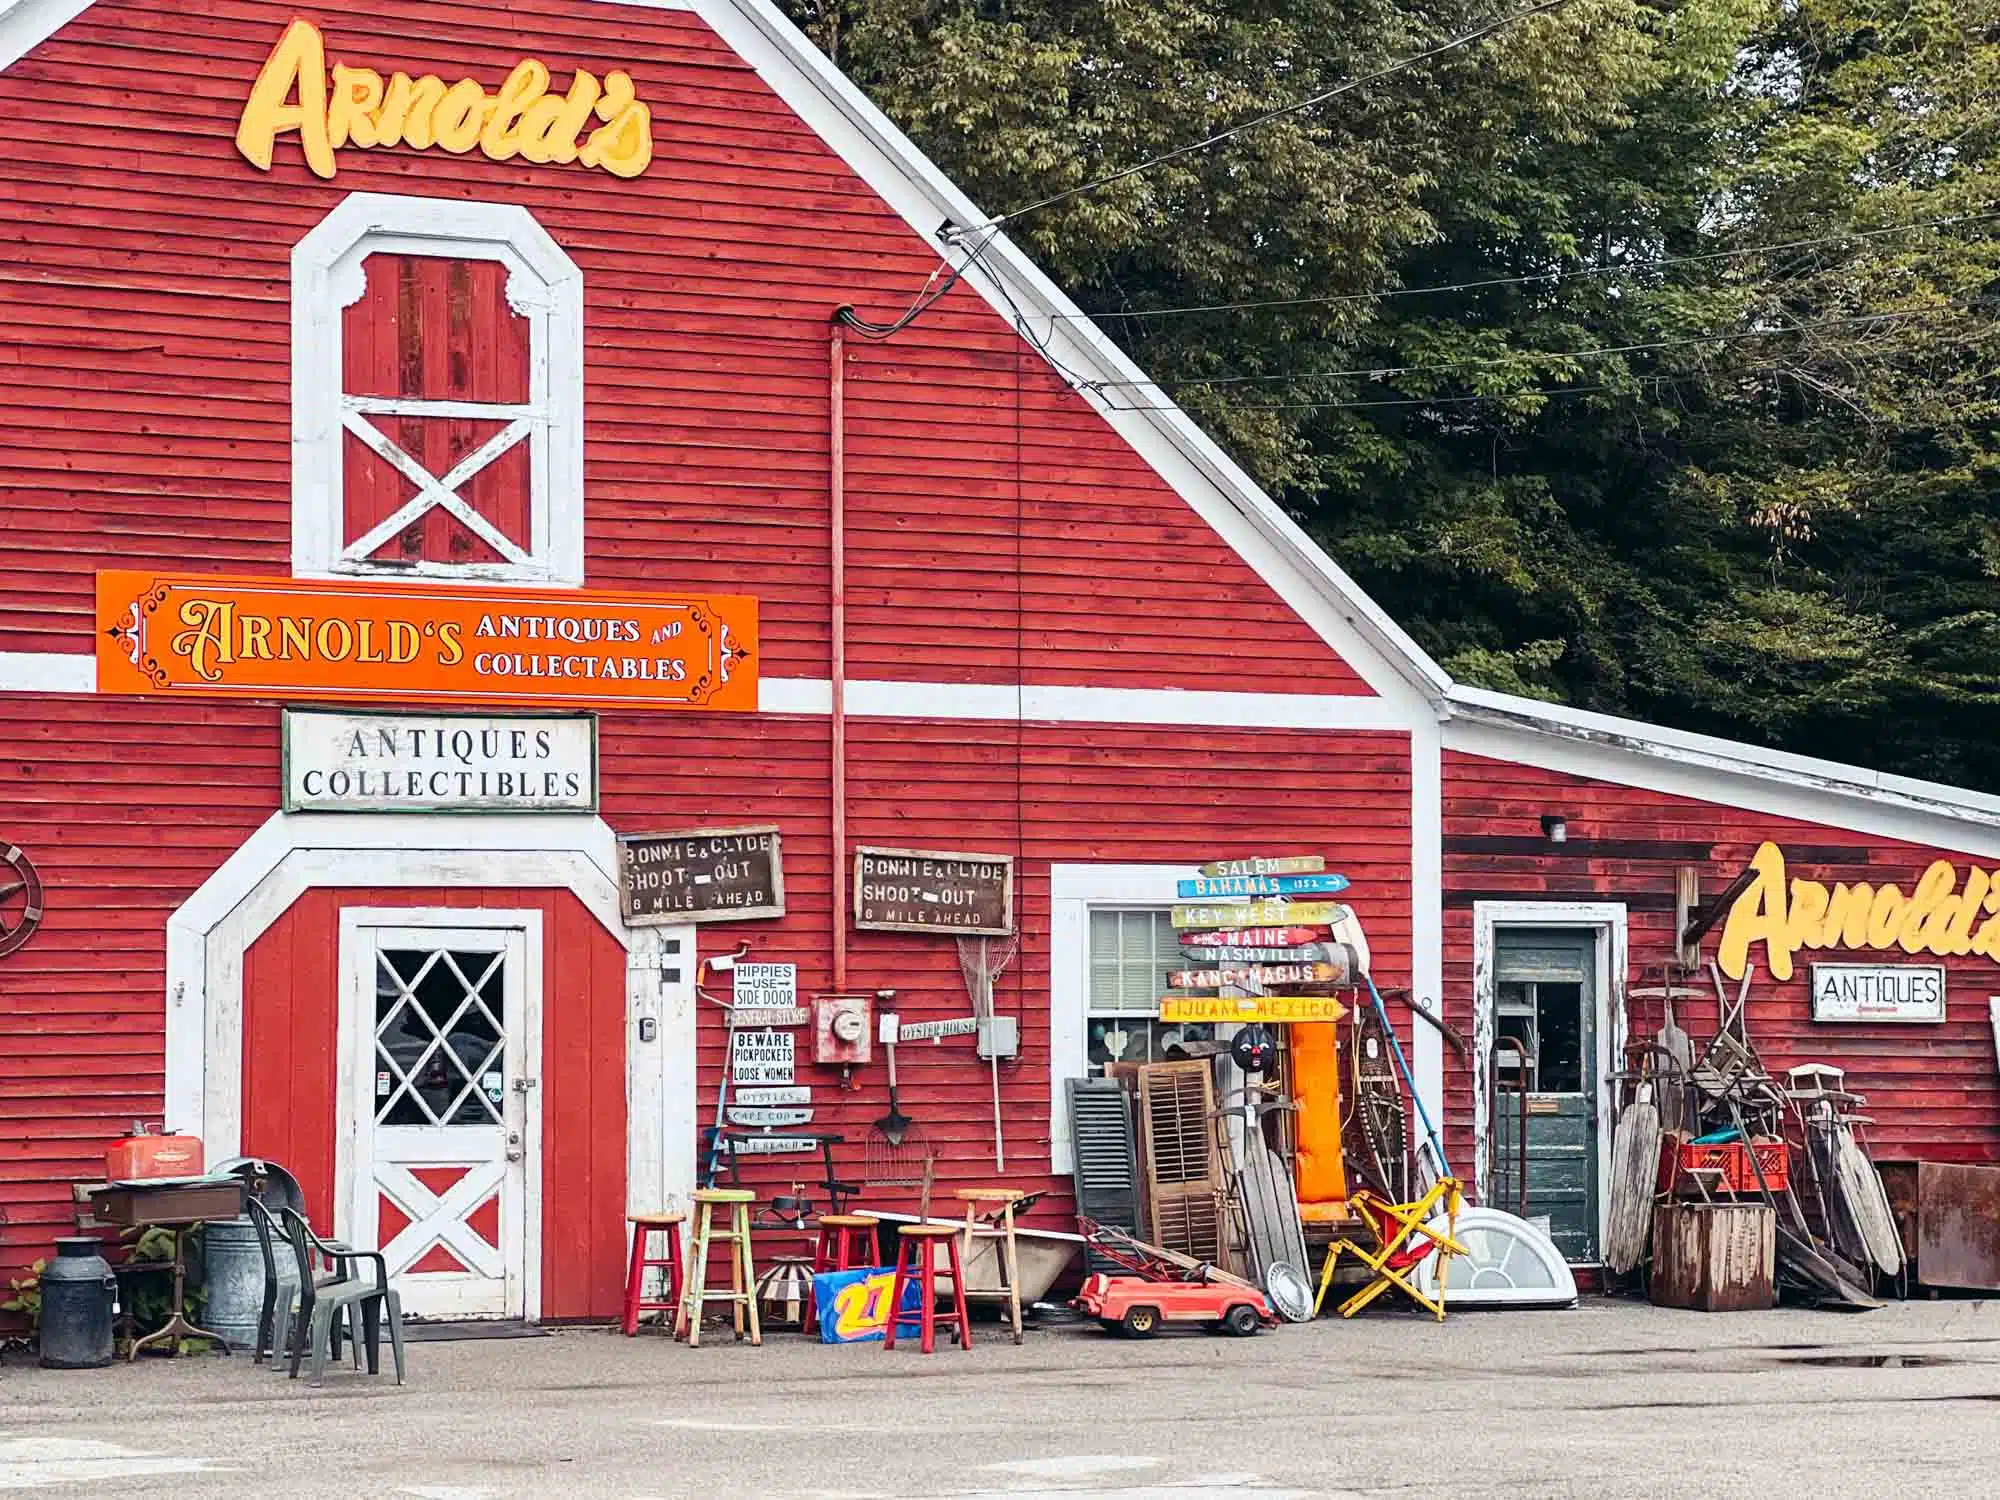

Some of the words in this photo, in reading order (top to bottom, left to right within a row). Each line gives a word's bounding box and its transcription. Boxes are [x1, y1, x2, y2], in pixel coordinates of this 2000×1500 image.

[475, 615, 641, 643] ANTIQUES
[650, 621, 683, 646] AND
[473, 653, 686, 681] COLLECTABLES
[348, 729, 551, 764] ANTIQUES
[302, 769, 580, 797] COLLECTIBLES
[1216, 858, 1281, 876] SALEM
[1195, 877, 1281, 895] BAHAMAS
[653, 895, 694, 910] MILE
[715, 890, 763, 906] AHEAD
[886, 909, 926, 923] MILE
[935, 911, 981, 925] AHEAD
[1185, 908, 1224, 924] KEY
[1233, 907, 1287, 923] WEST
[1227, 929, 1289, 946] MAINE
[1205, 948, 1313, 961] NASHVILLE
[737, 965, 792, 977] HIPPIES
[753, 979, 777, 989] USE
[1821, 975, 1937, 1004] ANTIQUES
[737, 990, 760, 1005] SIDE
[764, 990, 793, 1005] DOOR
[1163, 1000, 1240, 1017] TIJUANA
[1256, 1000, 1334, 1017] MEXICO
[738, 1034, 790, 1047] BEWARE
[735, 1048, 793, 1062] PICKPOCKETS
[734, 1067, 760, 1081] LOOSE
[764, 1067, 793, 1081] WOMEN
[834, 1271, 901, 1339] 27
